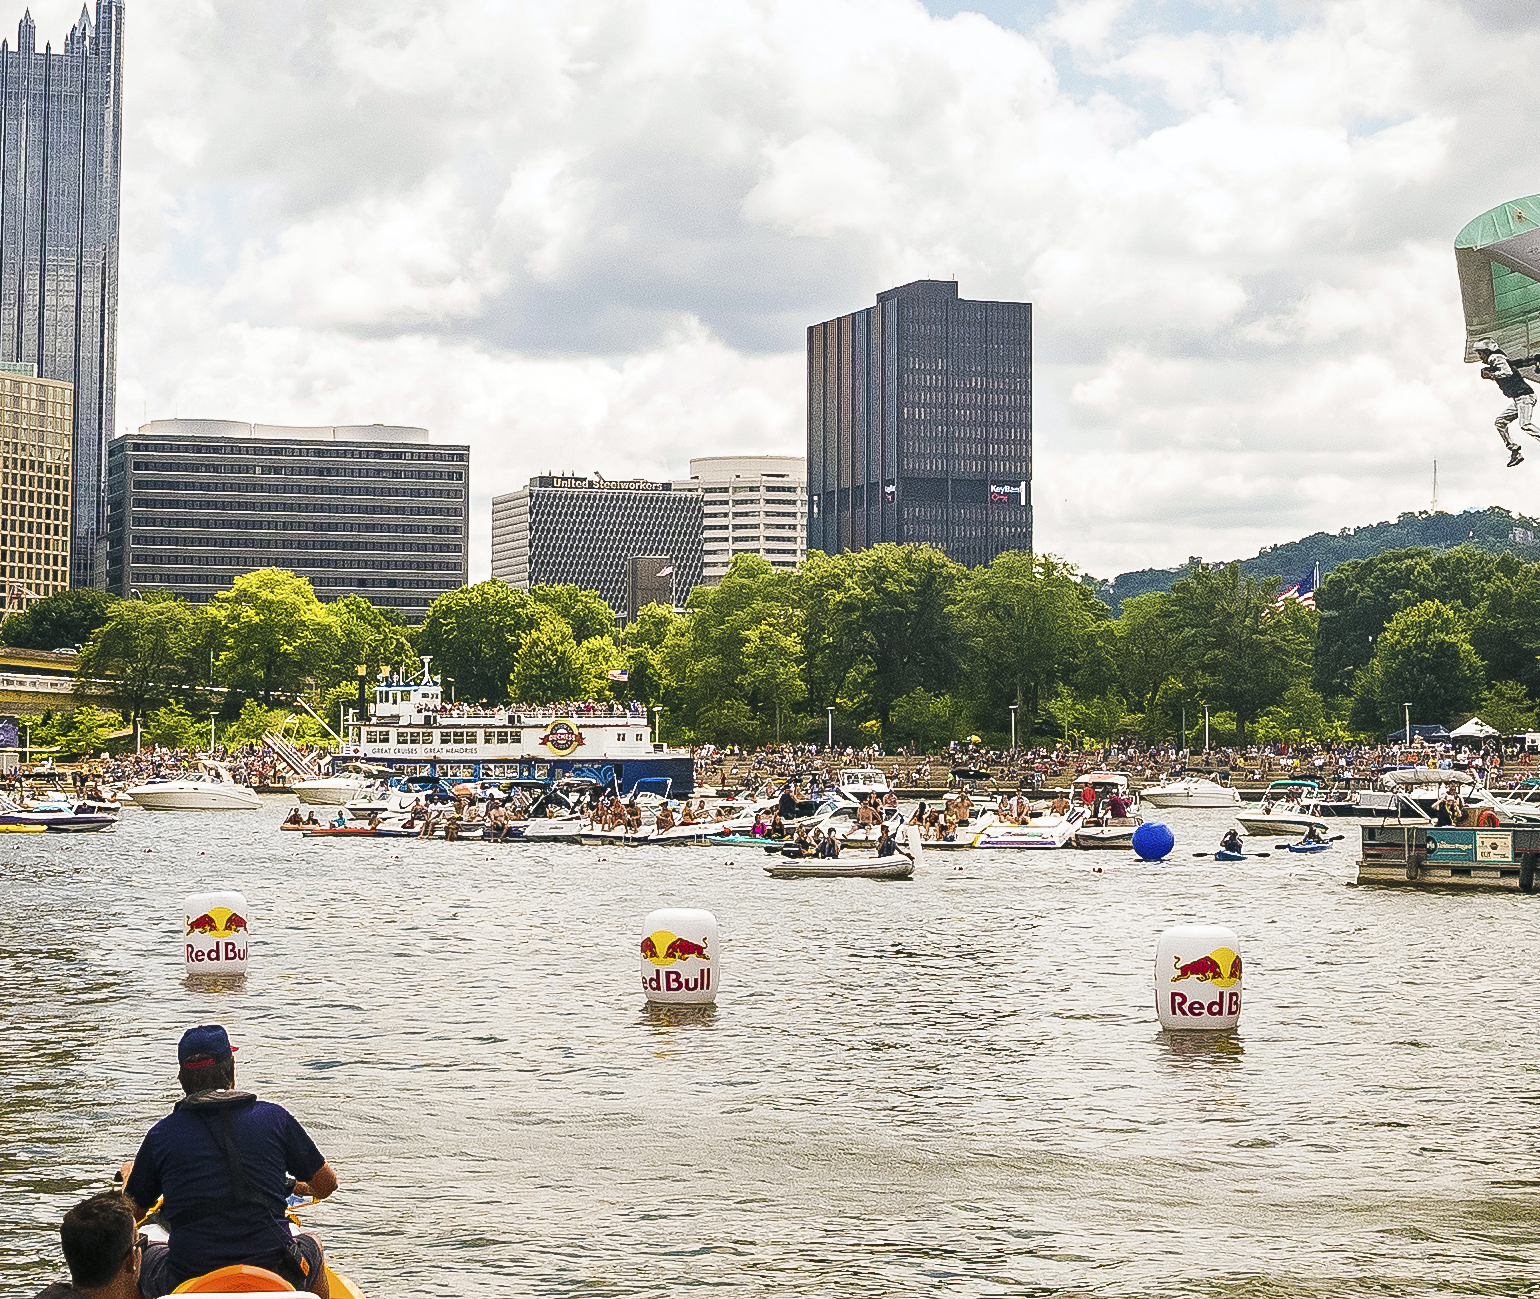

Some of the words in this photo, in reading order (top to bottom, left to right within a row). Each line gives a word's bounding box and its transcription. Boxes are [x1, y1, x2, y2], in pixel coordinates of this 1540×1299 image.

[553, 478, 589, 488] United
[592, 480, 663, 490] Steelworkers
[445, 747, 478, 755] MEMORIES
[185, 941, 220, 963] Red
[665, 967, 710, 992] Bull
[1170, 990, 1224, 1017] Red
[1227, 991, 1241, 1016] B
